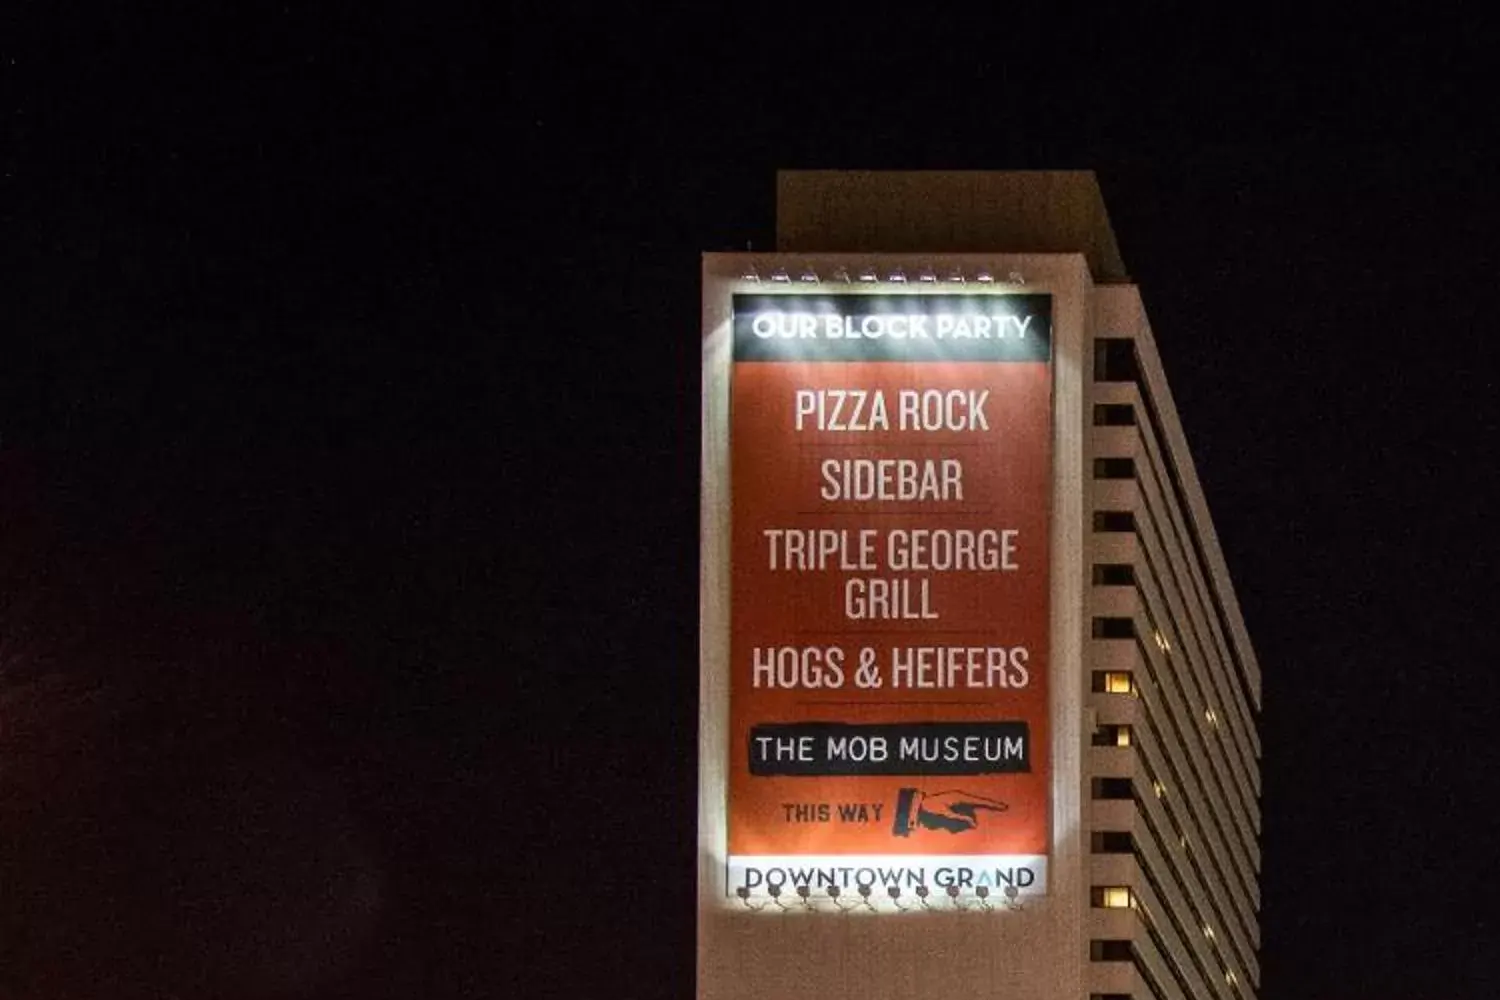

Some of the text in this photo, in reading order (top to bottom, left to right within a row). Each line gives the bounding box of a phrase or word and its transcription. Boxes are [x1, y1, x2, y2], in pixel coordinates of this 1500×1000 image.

[752, 314, 1032, 340] OUR BLOCK PARTY
[795, 389, 990, 431] PIZZA ROCK
[821, 459, 964, 501] SIDEBAR
[763, 529, 1020, 571] TRIPLE GEORGE
[845, 578, 939, 619] GRILL
[752, 647, 1030, 689] HOGS & HEIFERS
[755, 736, 1024, 762] THE MOB MUSEUM
[782, 803, 885, 824] THIS WAY
[745, 866, 1035, 890] DOWNTOWN GRAND
